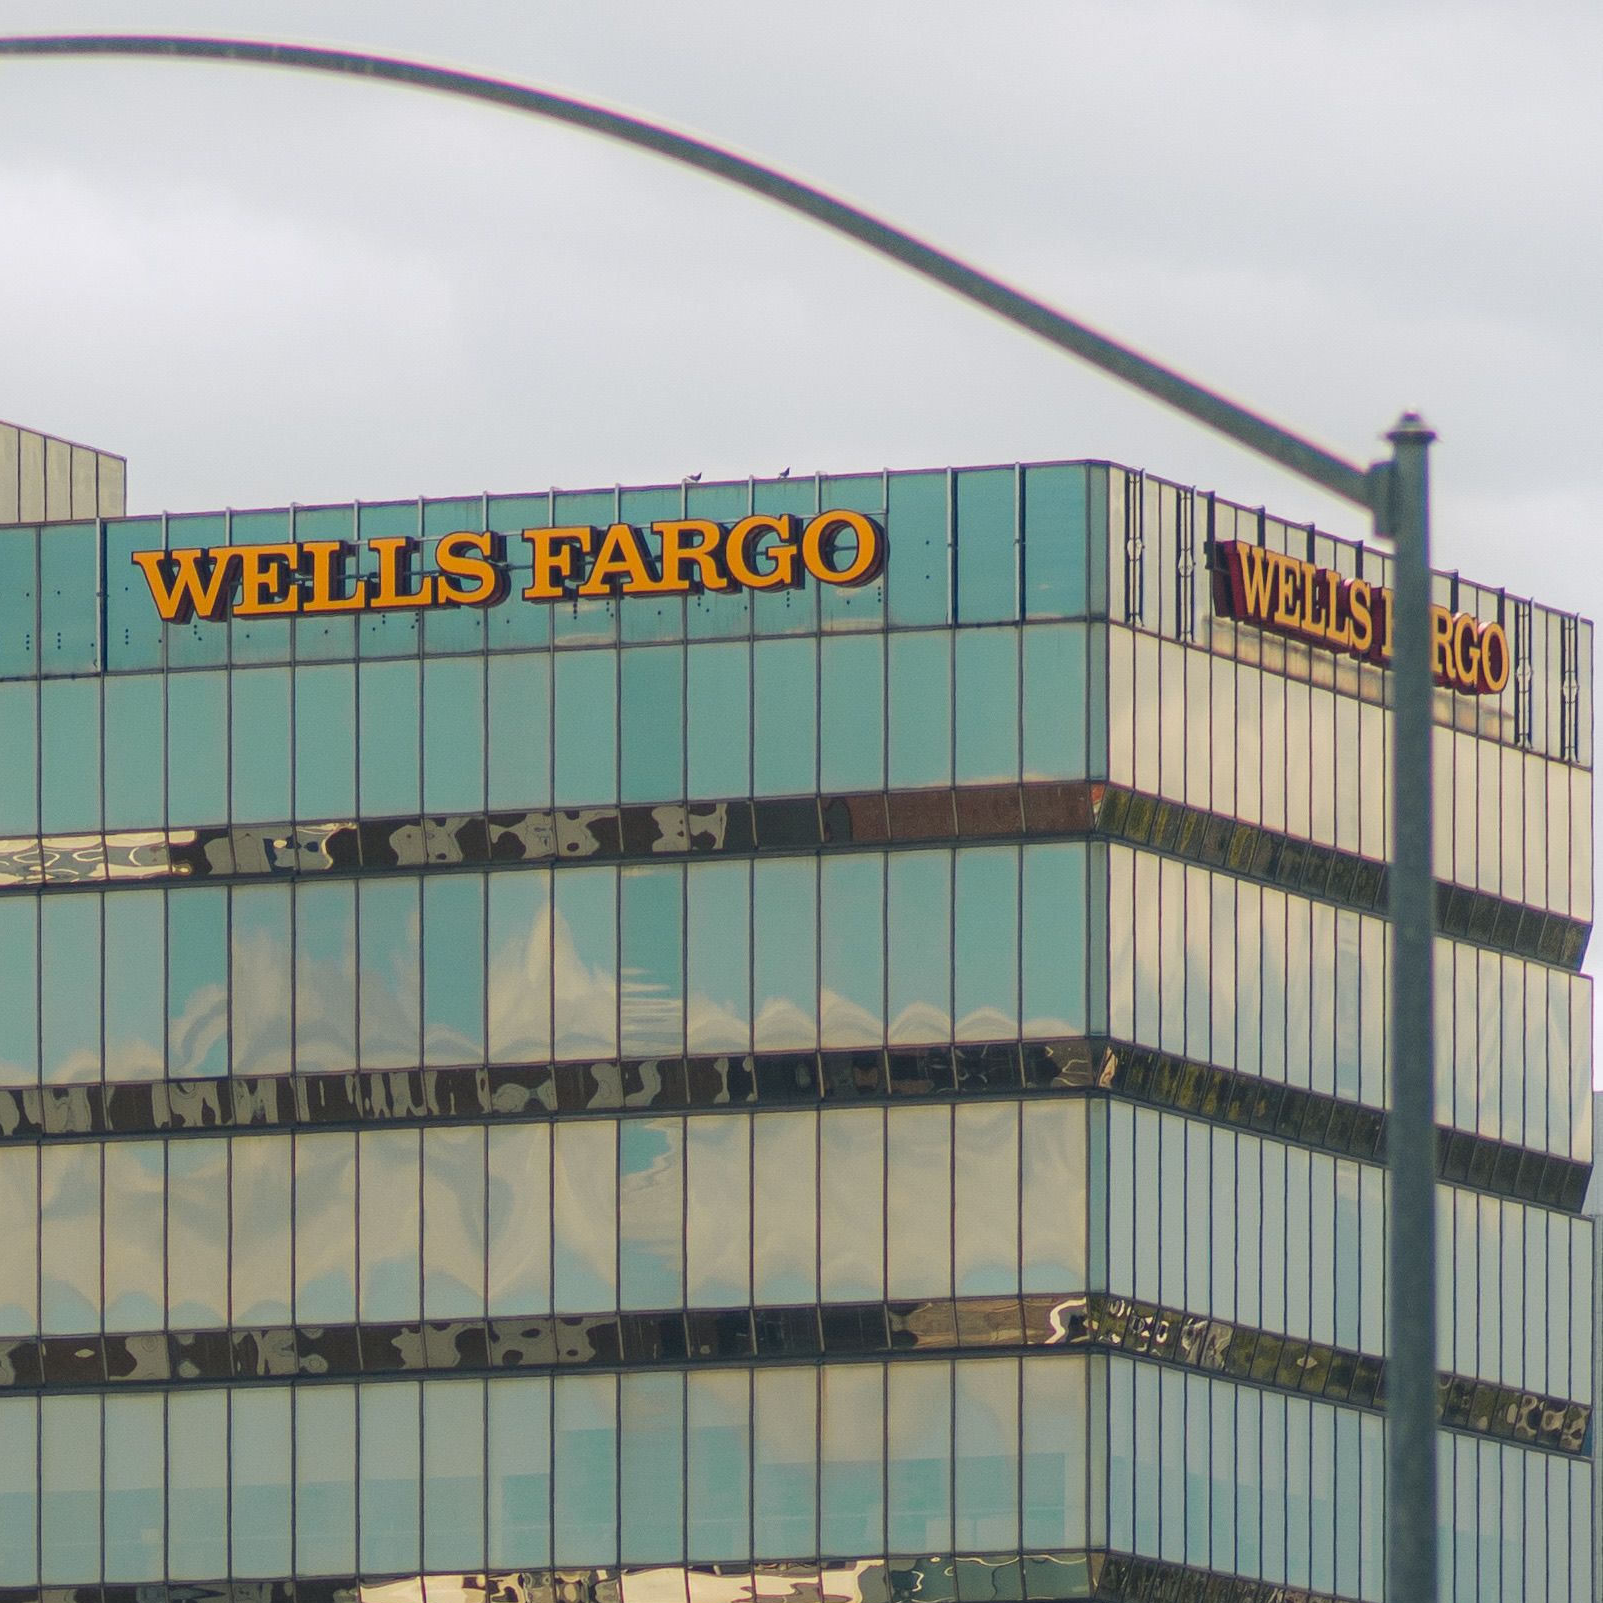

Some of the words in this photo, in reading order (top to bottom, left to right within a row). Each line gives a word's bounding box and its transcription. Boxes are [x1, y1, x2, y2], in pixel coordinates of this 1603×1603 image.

[131, 530, 505, 624] WELLS
[522, 508, 887, 602] FARGO
[1235, 541, 1374, 654] WELLS
